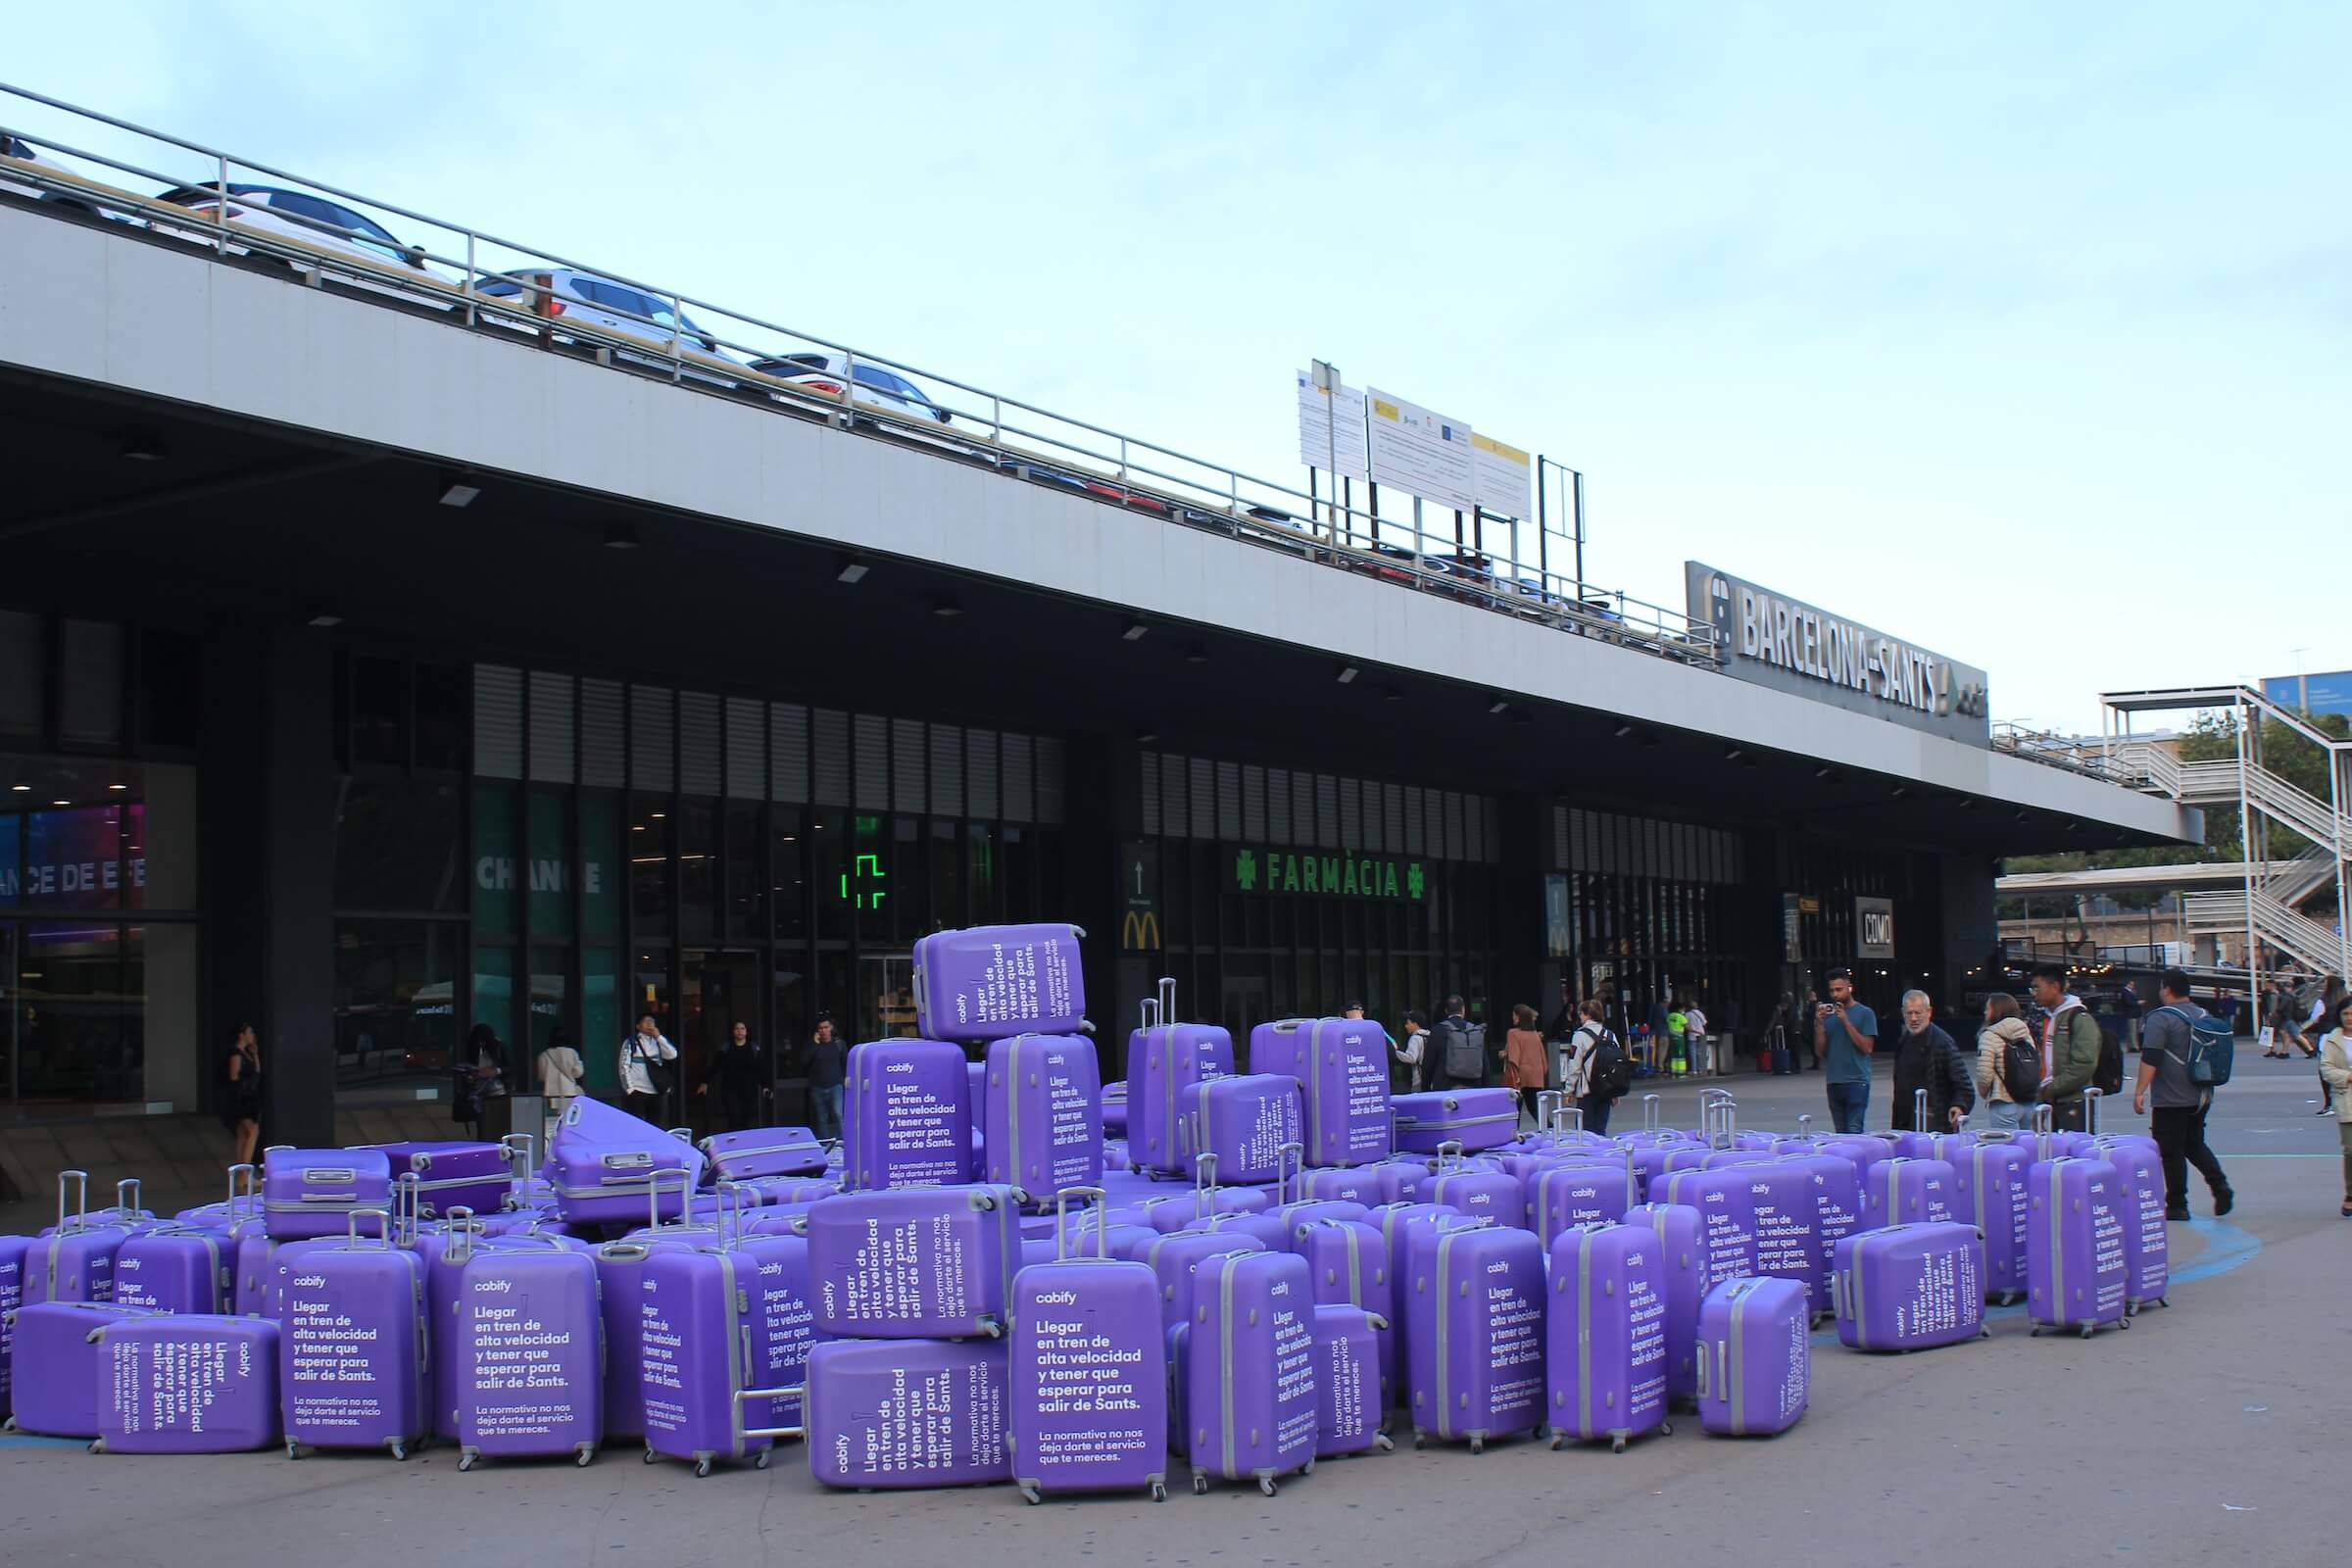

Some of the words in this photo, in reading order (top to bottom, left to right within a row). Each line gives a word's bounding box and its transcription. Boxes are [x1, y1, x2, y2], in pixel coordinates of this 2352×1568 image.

[1740, 587, 1936, 712] BARCELONA-SANTS
[63, 863, 95, 891] DE
[1268, 848, 1399, 897] FARMÀCIA
[1865, 912, 1890, 944] COMO
[1016, 950, 1027, 975] para
[1025, 944, 1035, 976] Sants.
[985, 967, 994, 981] de
[992, 944, 1005, 997] velocidad
[1006, 959, 1016, 980] que
[1027, 979, 1037, 993] de
[987, 983, 997, 1005] tren
[1008, 982, 1017, 1011] tener
[1018, 977, 1030, 1019] esperar
[956, 993, 967, 1023] cabify
[977, 987, 988, 1022] Llegar
[998, 999, 1007, 1020] alta
[1028, 995, 1038, 1018] salir
[990, 1007, 998, 1021] en
[1347, 1054, 1365, 1065] Llegar
[886, 1062, 913, 1073] cabify
[887, 1083, 918, 1096] Llegar
[923, 1093, 936, 1102] de
[888, 1105, 908, 1116] alta
[908, 1103, 956, 1114] velocidad
[888, 1120, 896, 1129] y
[896, 1118, 923, 1127] tener
[923, 1117, 942, 1127] que
[888, 1130, 926, 1141] esperar
[927, 1128, 950, 1139] para
[889, 1139, 910, 1150] salir
[911, 1139, 924, 1149] de
[925, 1138, 956, 1148] Sants.
[1469, 1194, 1491, 1205] cabify
[1572, 1188, 1596, 1200] cabify
[1573, 1208, 1601, 1220] Llegar
[1759, 1216, 1778, 1225] tren
[1779, 1214, 1791, 1224] de
[1767, 1225, 1810, 1237] velocidad
[1780, 1239, 1797, 1249] que
[1784, 1250, 1805, 1260] para
[1487, 1260, 1508, 1273] cabify
[1771, 1260, 1781, 1270] de
[1782, 1258, 1810, 1269] Sants.
[293, 1275, 325, 1288] cabify
[474, 1280, 512, 1293] cabify
[823, 1281, 835, 1319] cabify
[846, 1275, 858, 1319] Llegar
[1036, 1291, 1076, 1305] cabify
[1489, 1288, 1513, 1299] Llegar
[293, 1300, 329, 1314] Llegar
[1490, 1303, 1500, 1313] en
[1500, 1300, 1516, 1311] tren
[1517, 1297, 1526, 1308] de
[309, 1315, 333, 1326] tren
[335, 1314, 351, 1326] de
[474, 1306, 516, 1320] Llegar
[1490, 1314, 1506, 1327] alta
[1506, 1309, 1540, 1324] velocidad
[474, 1323, 491, 1332] en
[493, 1321, 520, 1332] tren
[523, 1319, 541, 1331] de
[1036, 1320, 1083, 1336] Llegar
[1896, 1306, 1905, 1338] cabify
[293, 1328, 317, 1340] alta
[318, 1328, 376, 1340] velocidad
[475, 1335, 501, 1347] alta
[504, 1332, 569, 1346] velocidad
[1037, 1340, 1054, 1348] en
[1057, 1337, 1088, 1348] tren
[1091, 1335, 1109, 1348] de
[1491, 1332, 1496, 1343] y
[1496, 1328, 1517, 1339] tener
[1518, 1326, 1531, 1337] que
[293, 1345, 301, 1355] y
[302, 1343, 334, 1353] tener
[335, 1345, 358, 1355] que
[1491, 1342, 1520, 1355] esperar
[1521, 1338, 1537, 1350] para
[293, 1358, 338, 1369] esperar
[340, 1358, 368, 1369] para
[475, 1351, 483, 1363] y
[485, 1349, 521, 1360] tener
[523, 1349, 549, 1361] que
[1037, 1351, 1066, 1364] alta
[1069, 1348, 1141, 1363] velocidad
[1491, 1354, 1508, 1368] salir
[1509, 1352, 1519, 1364] de
[1519, 1351, 1540, 1362] Sants.
[293, 1369, 318, 1380] salir
[320, 1369, 336, 1381] de
[338, 1369, 375, 1381] Sants.
[475, 1365, 527, 1377] esperar
[529, 1363, 561, 1376] para
[1038, 1371, 1047, 1384] y
[1049, 1368, 1089, 1380] tener
[1092, 1369, 1119, 1382] que
[475, 1377, 505, 1389] salir
[507, 1376, 523, 1388] de
[526, 1375, 568, 1387] Sants.
[926, 1377, 939, 1411] para
[938, 1368, 951, 1412] Sants.
[1038, 1386, 1095, 1399] esperar
[1098, 1384, 1132, 1397] para
[305, 1396, 348, 1405] normativa
[892, 1368, 906, 1440] velocidad
[911, 1391, 923, 1417] que
[1038, 1398, 1070, 1412] salir
[1073, 1398, 1092, 1411] de
[1095, 1397, 1140, 1410] Sants.
[294, 1405, 313, 1417] deja
[314, 1406, 337, 1415] darte
[338, 1406, 346, 1415] el
[877, 1400, 891, 1418] de
[939, 1416, 952, 1434] de
[880, 1422, 892, 1451] tren
[910, 1420, 922, 1458] tener
[927, 1414, 940, 1468] esperar
[1039, 1432, 1052, 1441] La
[1054, 1430, 1106, 1441] normativa
[836, 1434, 851, 1473] cabify
[864, 1427, 879, 1472] Llegar
[939, 1437, 952, 1467] salir
[1039, 1442, 1063, 1453] deja
[1063, 1441, 1092, 1451] darte
[1095, 1440, 1103, 1450] el
[1106, 1439, 1146, 1449] servicio
[882, 1454, 892, 1471] en
[894, 1443, 906, 1470] alta
[1039, 1455, 1058, 1465] que
[1074, 1453, 1120, 1462] mereces.
[912, 1460, 925, 1469] y
